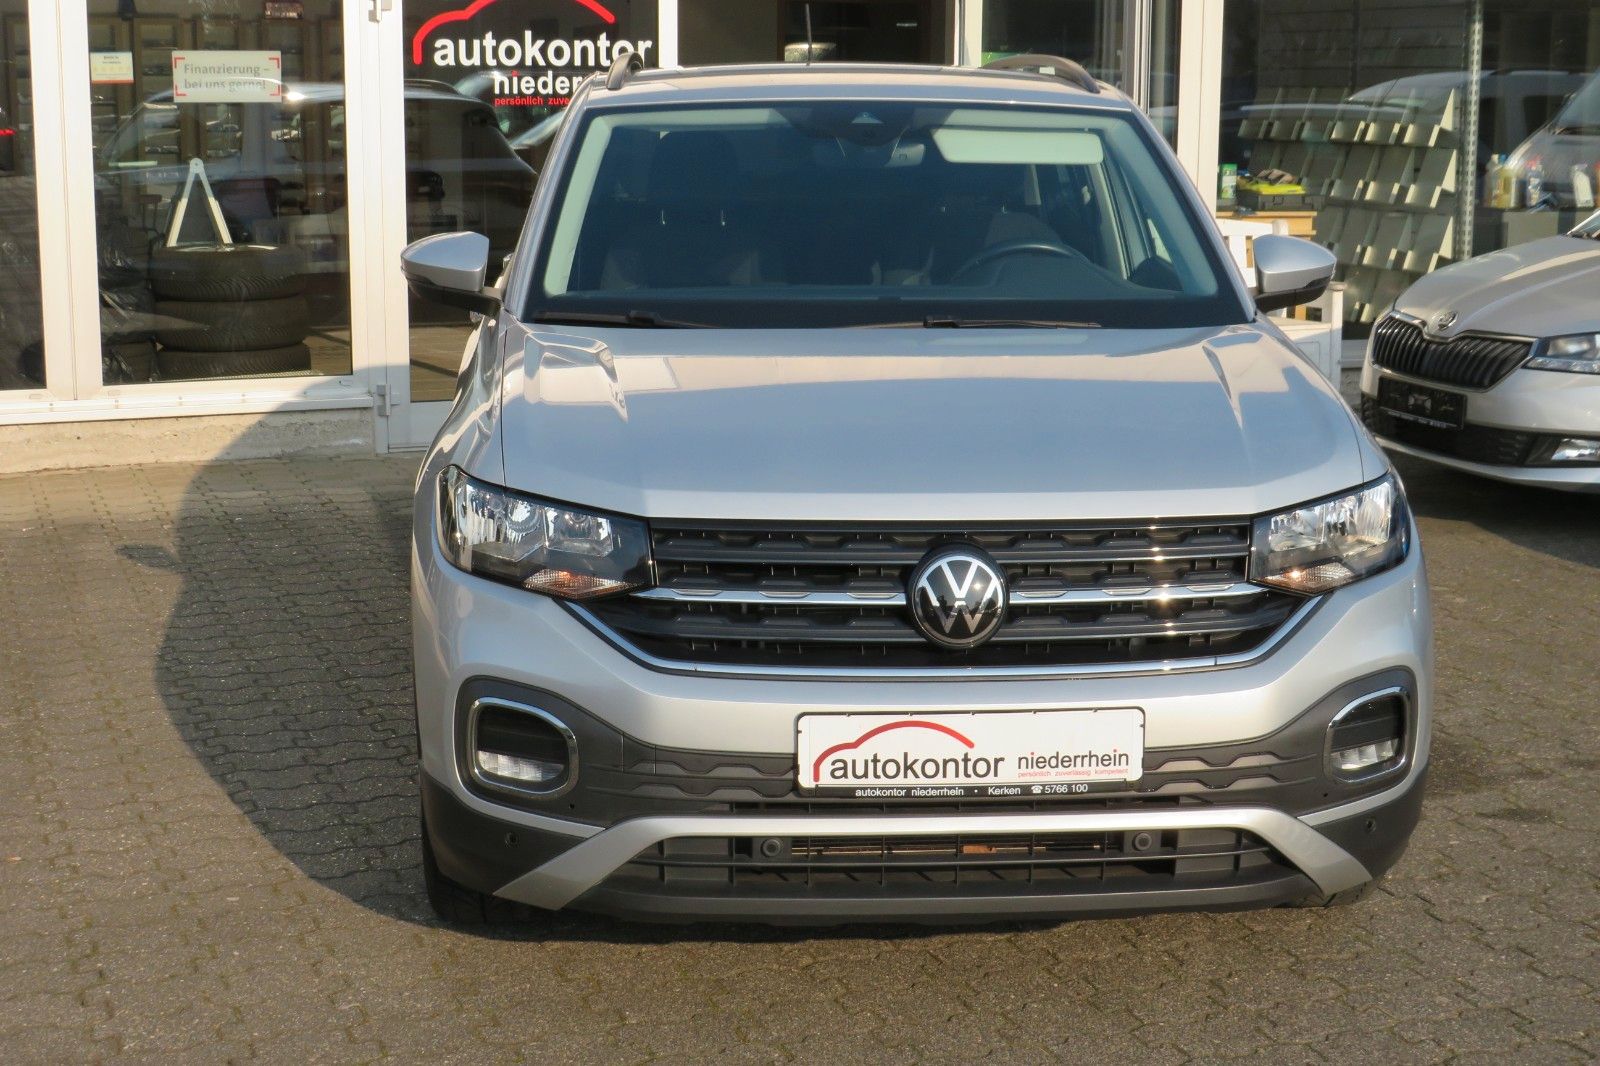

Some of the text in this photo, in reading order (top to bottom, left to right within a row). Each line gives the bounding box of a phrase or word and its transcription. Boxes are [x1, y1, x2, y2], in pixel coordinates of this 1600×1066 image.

[433, 29, 653, 67] autokontor
[184, 64, 260, 76] Finanzierung
[184, 78, 202, 89] bei
[493, 70, 583, 95] nieder
[494, 96, 570, 107] persönlich zuve
[830, 752, 1005, 779] autokontor
[1018, 749, 1129, 769] niederrhein
[1017, 768, 1129, 778] persönlich zuverlässig kompetent
[855, 784, 1088, 797] autokontor niederrhein Kerken 5766 100
